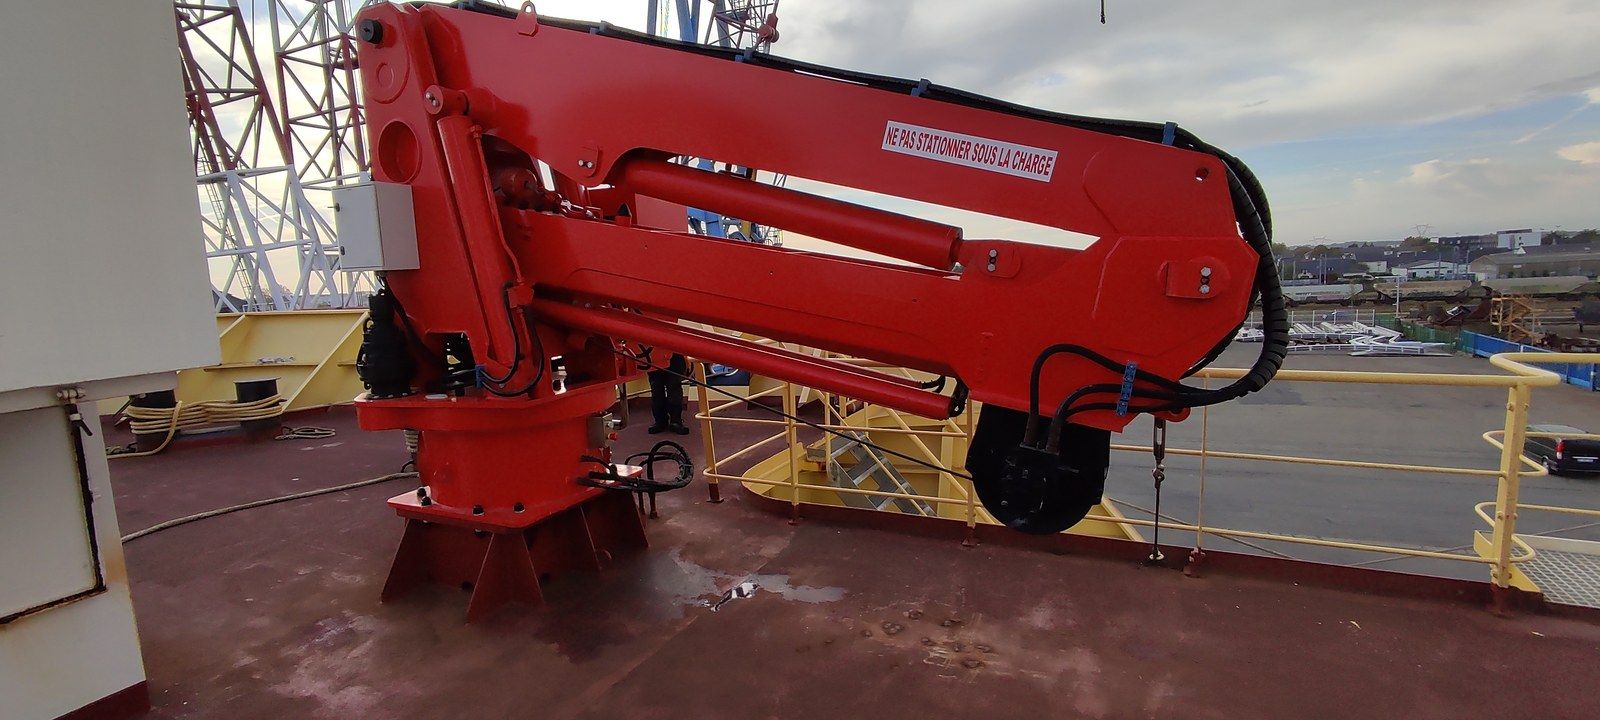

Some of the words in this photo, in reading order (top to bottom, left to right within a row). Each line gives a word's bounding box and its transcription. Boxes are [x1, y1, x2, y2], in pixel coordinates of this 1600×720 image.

[886, 127, 900, 146] NE
[899, 129, 917, 150] PAS
[916, 132, 972, 160] STATIONNER
[971, 142, 998, 166] SOUS
[997, 147, 1010, 169] LA
[1011, 150, 1053, 176] CHARGE
